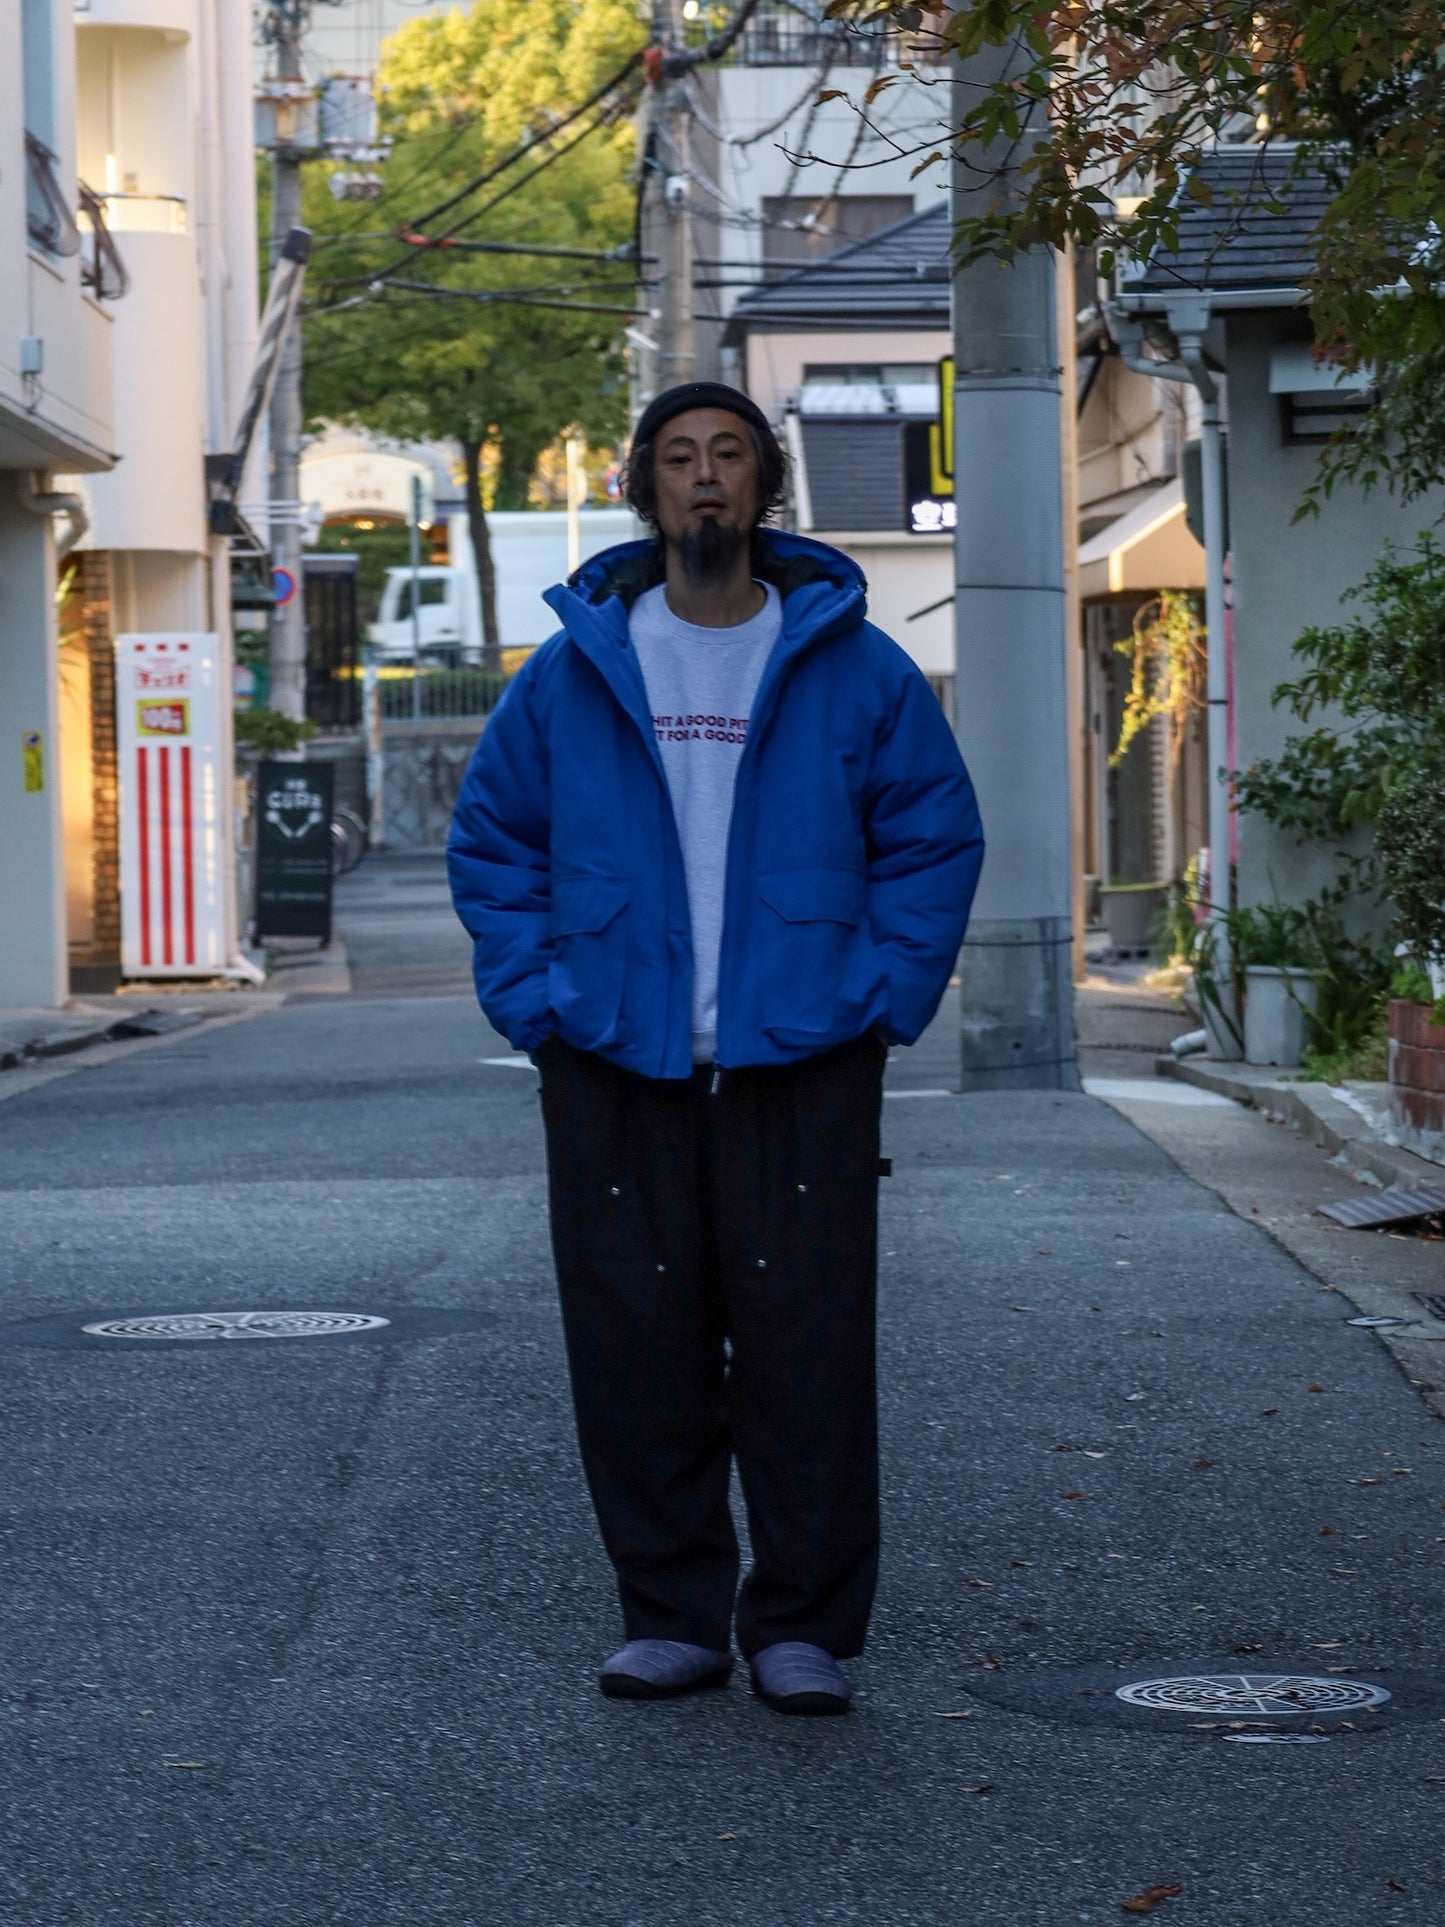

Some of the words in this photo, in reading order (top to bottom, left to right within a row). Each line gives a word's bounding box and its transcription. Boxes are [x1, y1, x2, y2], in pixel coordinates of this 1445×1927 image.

[675, 715, 684, 727] A
[686, 714, 726, 728] GOOD
[667, 730, 689, 741] FOR
[692, 729, 700, 740] A
[705, 729, 747, 744] GOOD
